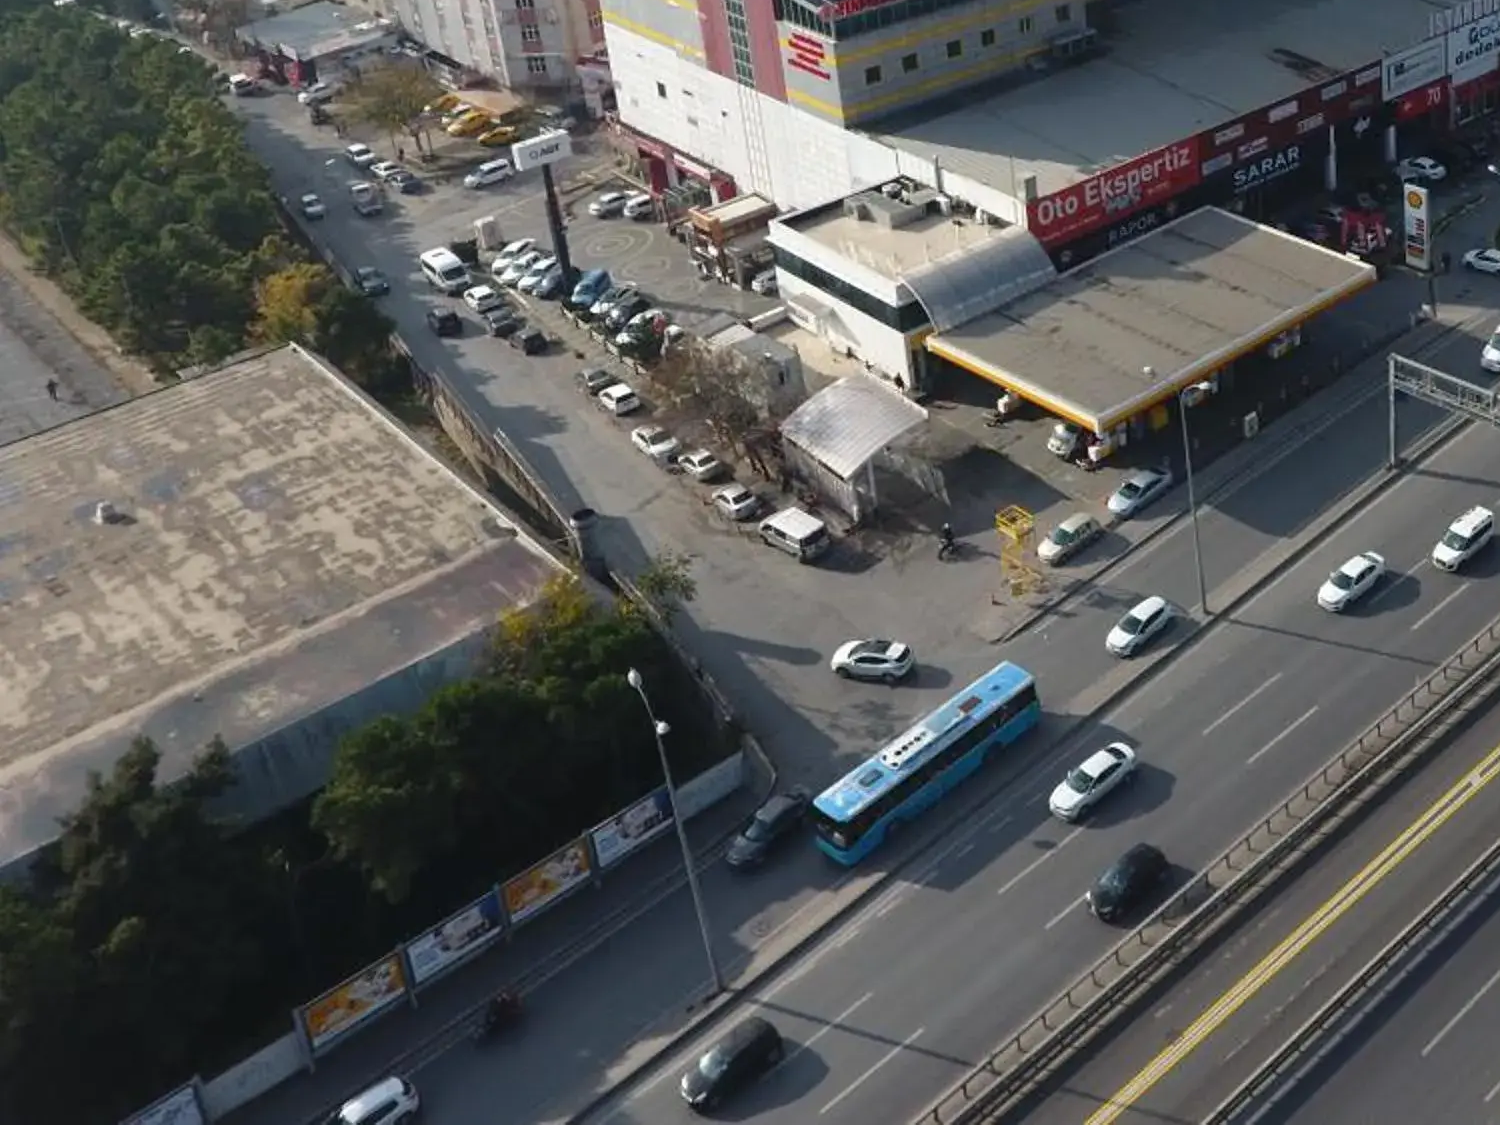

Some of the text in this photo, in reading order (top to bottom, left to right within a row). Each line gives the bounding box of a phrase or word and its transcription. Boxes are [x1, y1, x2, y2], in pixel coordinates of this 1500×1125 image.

[1037, 194, 1079, 225] Oto
[1083, 146, 1191, 207] Ekspertiz
[1233, 145, 1299, 187] SARAR
